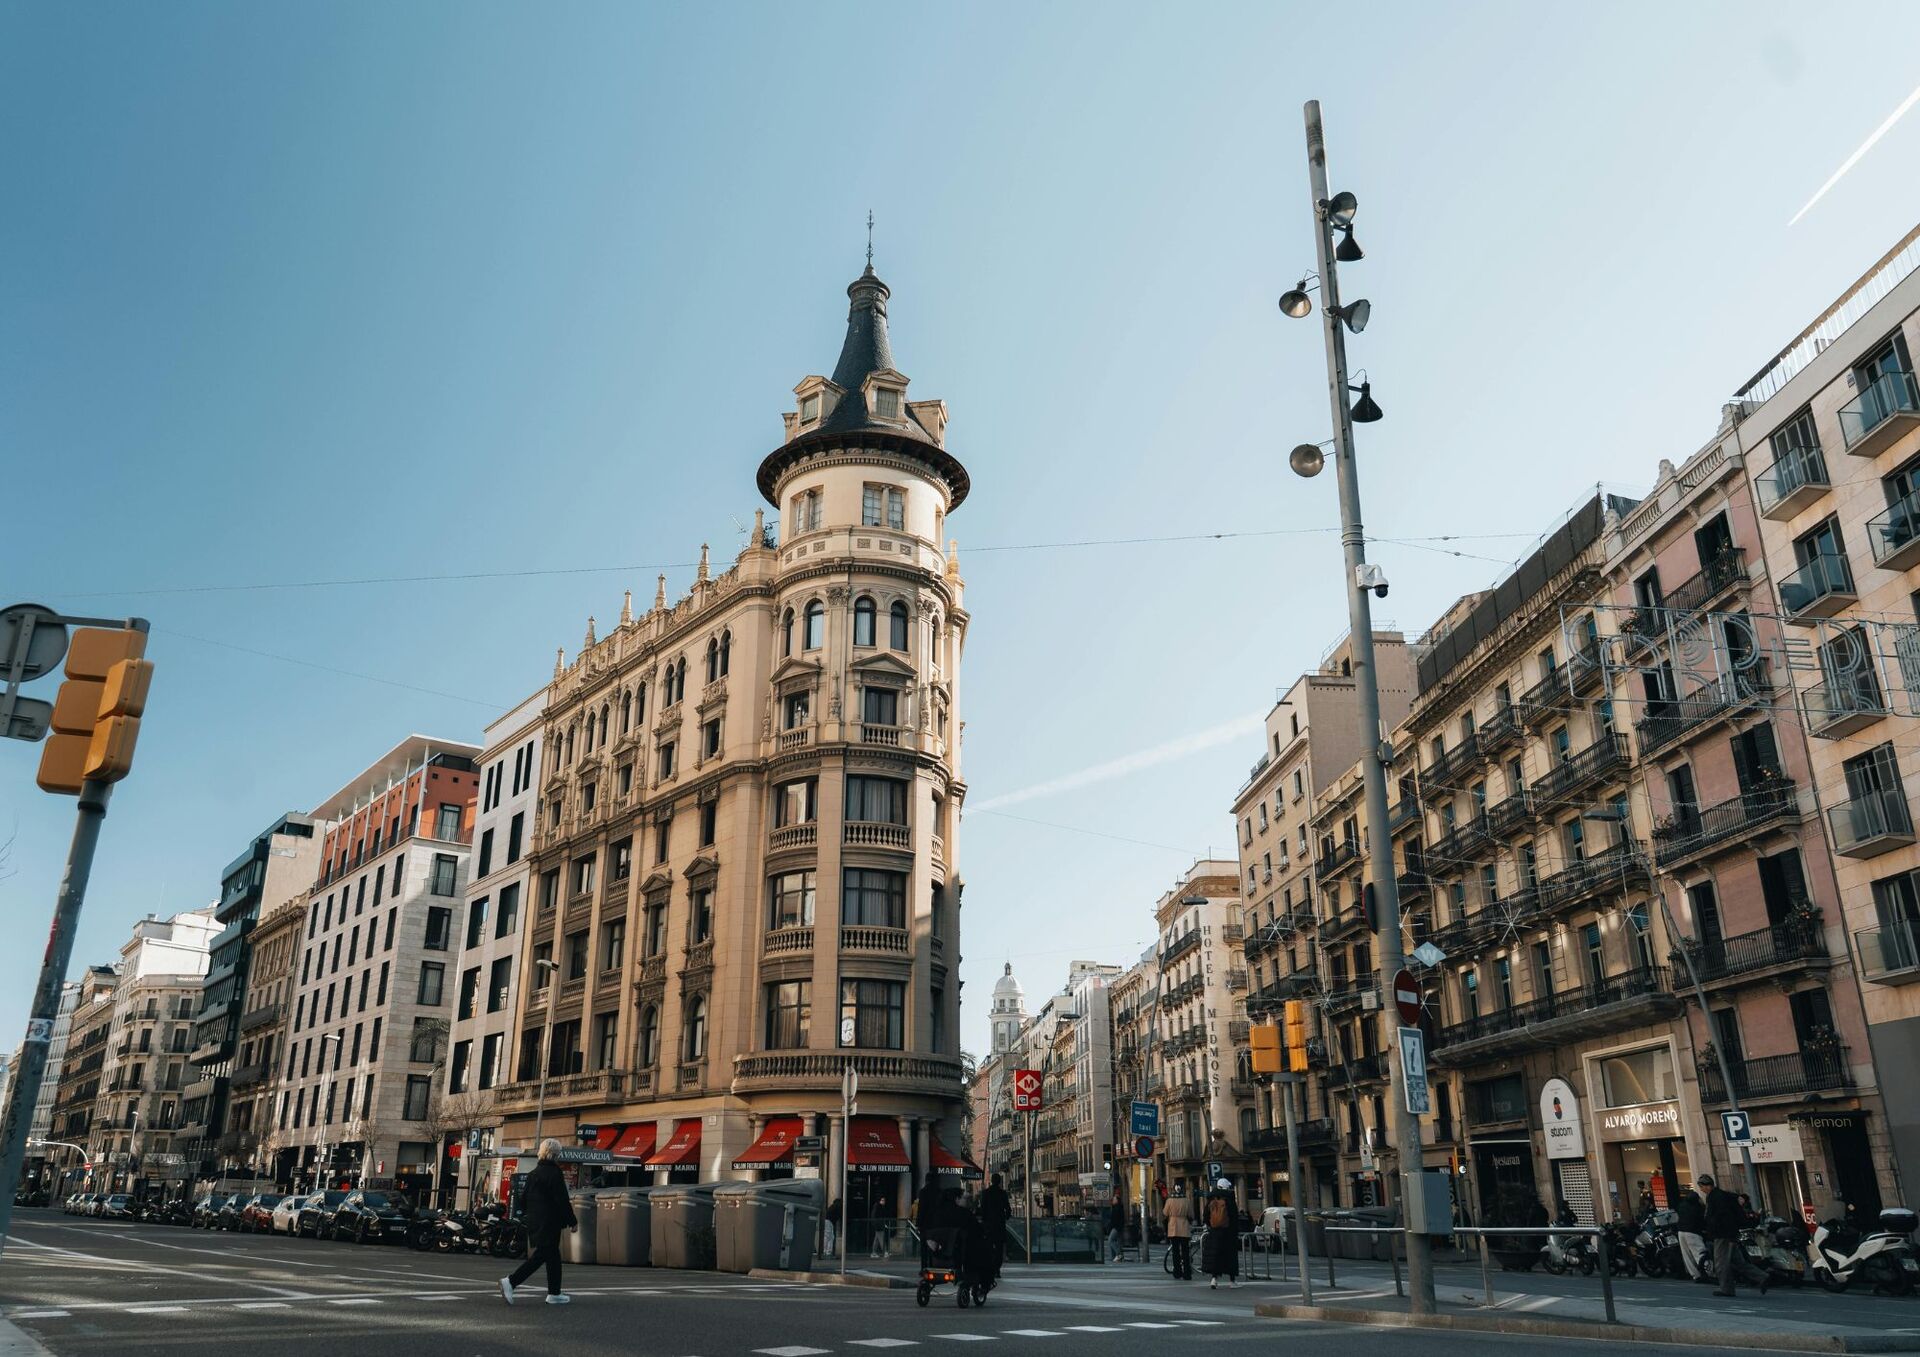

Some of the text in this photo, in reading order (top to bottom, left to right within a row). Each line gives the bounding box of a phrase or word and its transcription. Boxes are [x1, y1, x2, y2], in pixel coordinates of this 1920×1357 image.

[1202, 925, 1221, 1098] HOTEL MIDMOST
[1023, 1079, 1035, 1089] M
[1605, 1109, 1678, 1129] ALVARO MORENO
[1810, 1116, 1852, 1128] lemon
[1726, 1115, 1744, 1138] P
[470, 1130, 478, 1147] P
[563, 1150, 611, 1161] VANGUARDIA
[859, 1164, 877, 1172] SALON
[938, 1166, 964, 1175] MARNI
[1210, 1163, 1221, 1177] P
